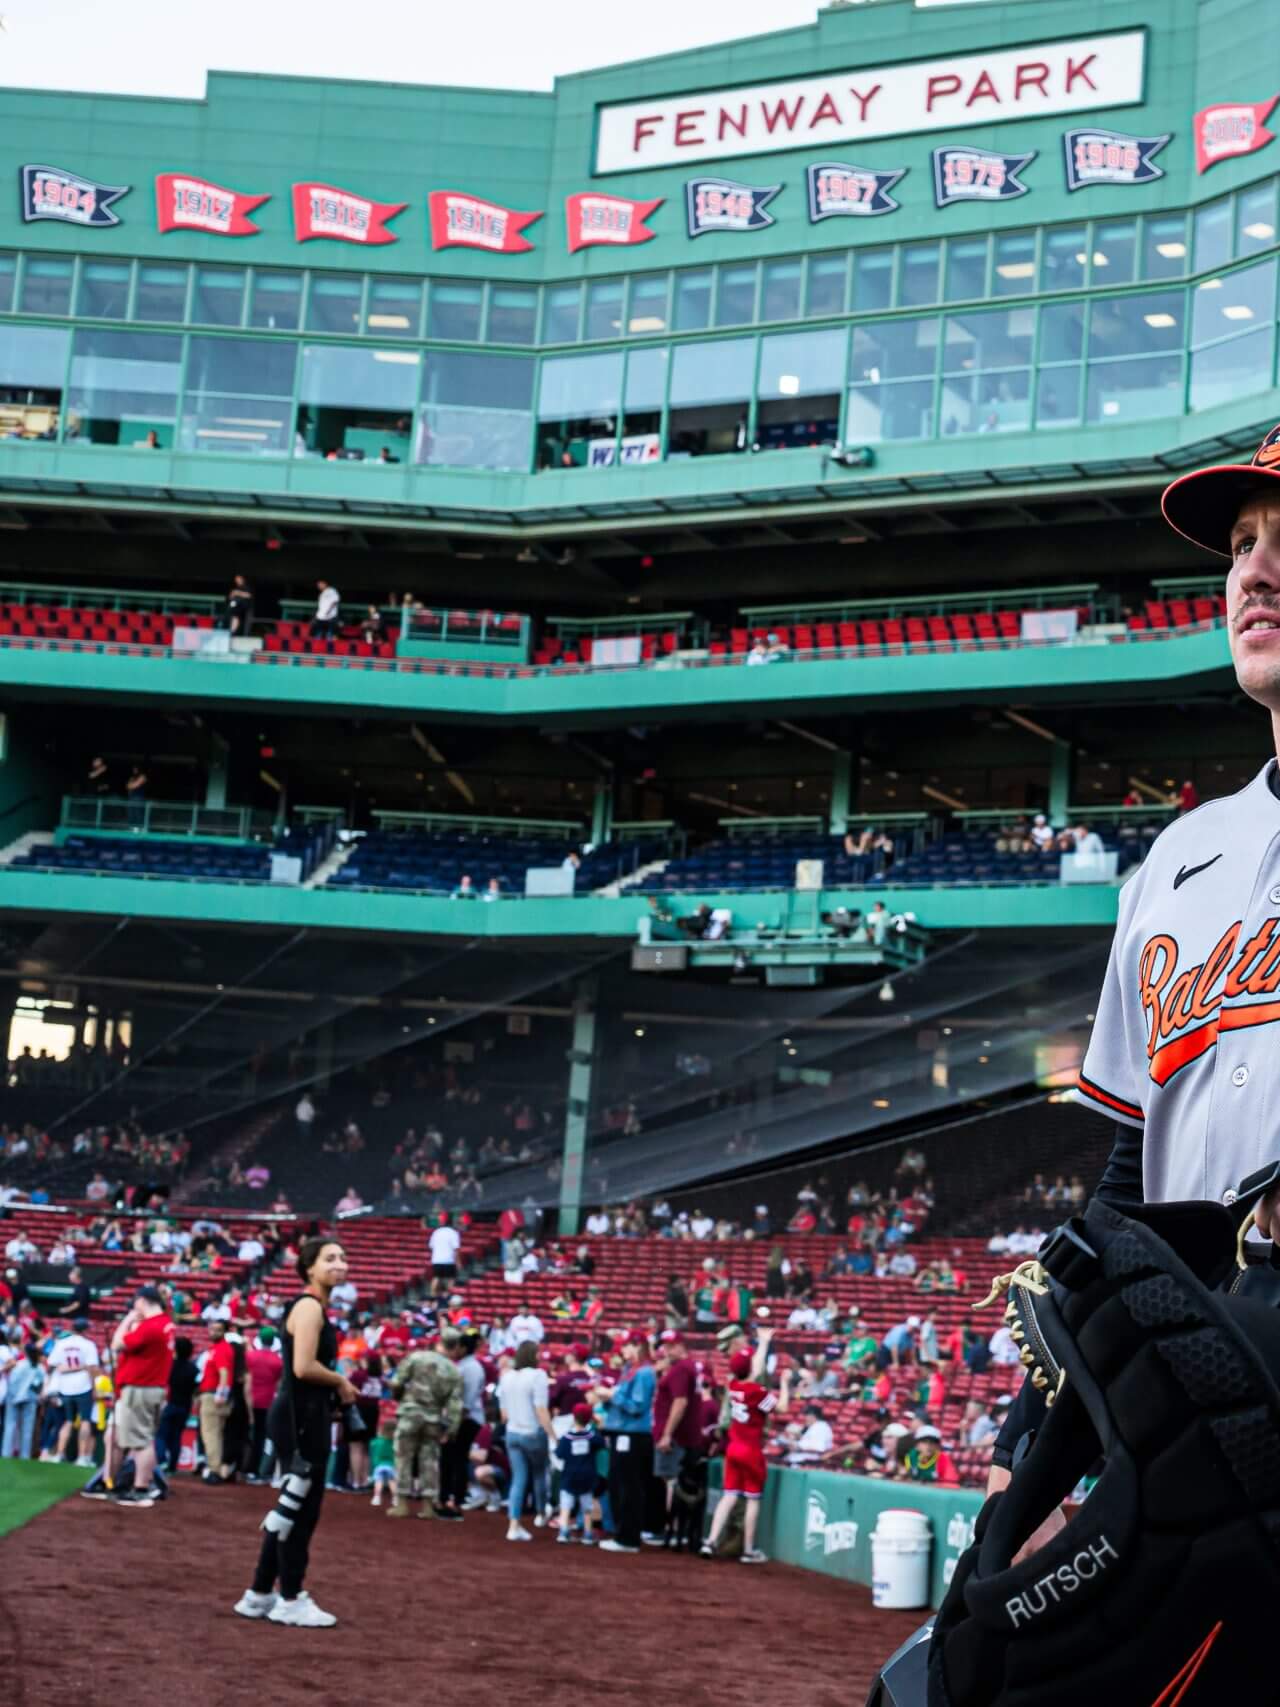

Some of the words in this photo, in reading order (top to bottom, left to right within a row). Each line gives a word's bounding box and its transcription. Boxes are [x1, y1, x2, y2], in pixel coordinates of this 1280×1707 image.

[634, 84, 882, 152] FENWAY
[926, 54, 1098, 113] PARK
[1075, 143, 1140, 170] 1986
[817, 175, 878, 202] 1967
[944, 159, 1006, 188] 1975
[32, 178, 96, 213] 1904
[175, 190, 232, 222] 1912
[697, 190, 754, 218] 1946
[311, 198, 370, 231] 1915
[448, 207, 506, 237] 1916
[1005, 1534, 1120, 1629] RUTSCH
